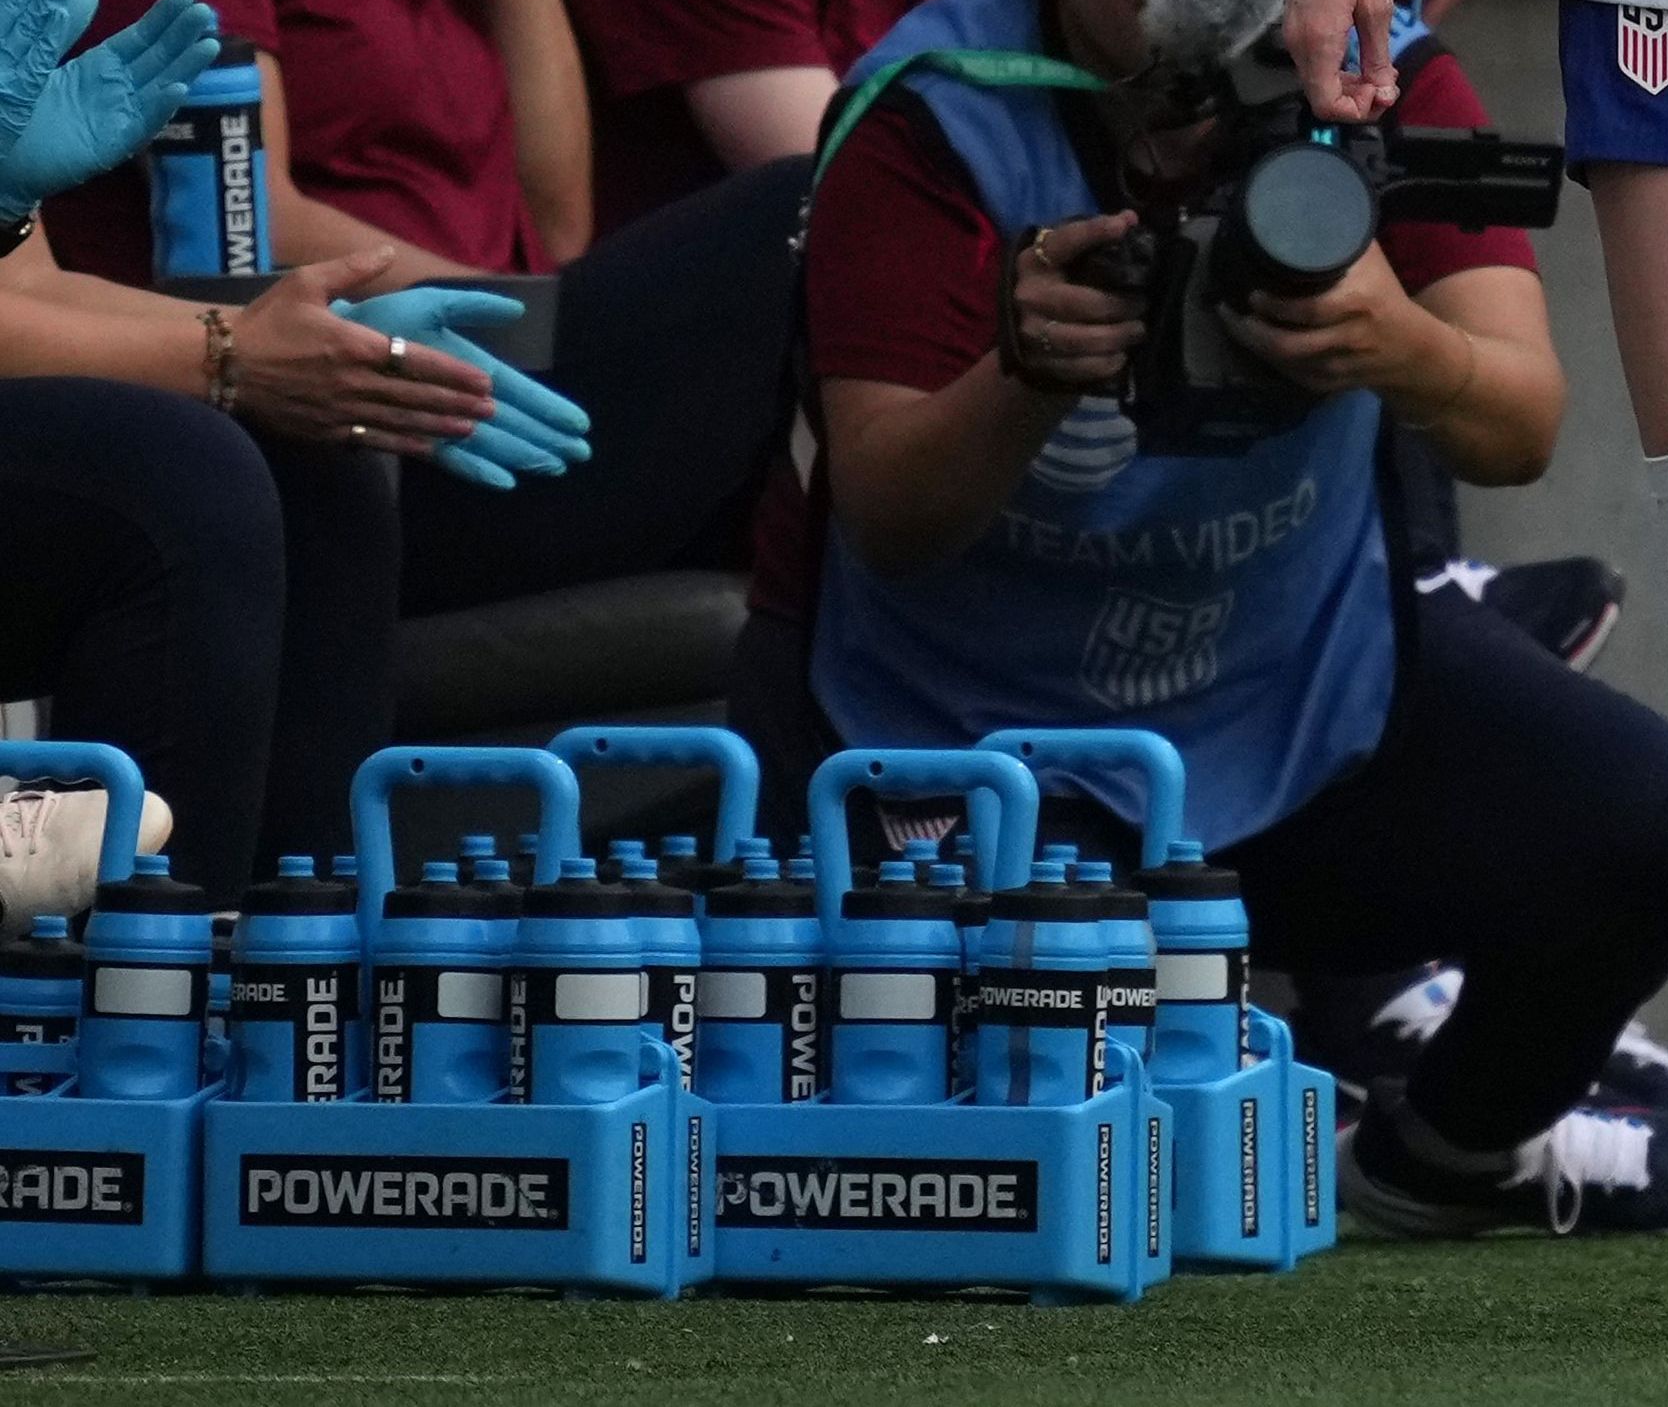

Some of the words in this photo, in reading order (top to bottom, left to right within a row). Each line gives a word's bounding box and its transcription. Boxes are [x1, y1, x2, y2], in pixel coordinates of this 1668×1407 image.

[1001, 508, 1154, 565] TEAM
[1171, 477, 1318, 573] VIDEO
[1106, 596, 1224, 656] USA
[307, 977, 338, 1103] RADE
[377, 979, 404, 1103] RADE
[791, 973, 816, 1104] POWE
[247, 1169, 550, 1218] POWERADE
[633, 1124, 644, 1257] POWERADE
[688, 1118, 700, 1254] POWERADE
[716, 1171, 1018, 1219] POWERADE
[1099, 1126, 1110, 1263] POWERADE
